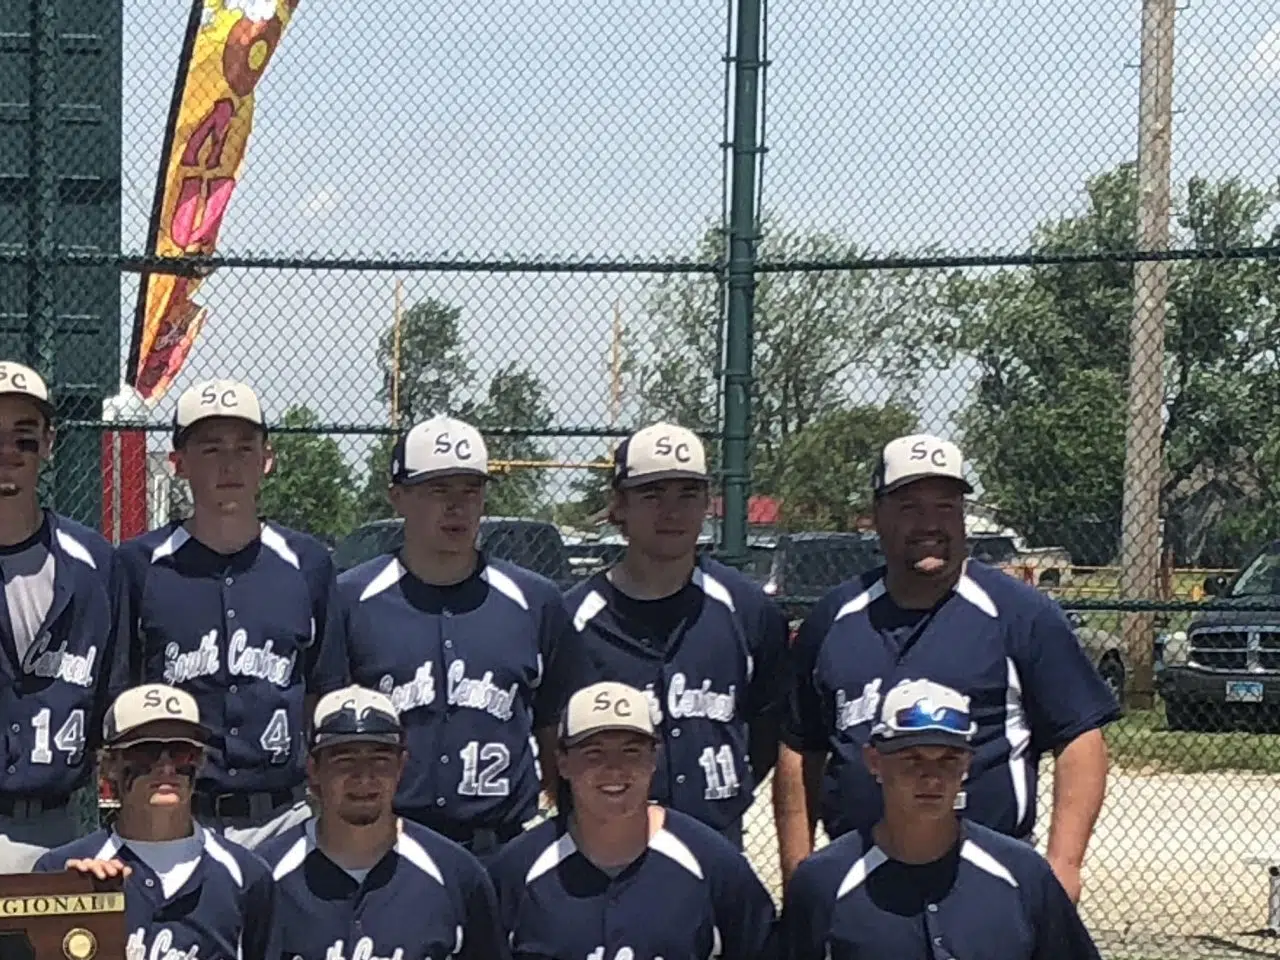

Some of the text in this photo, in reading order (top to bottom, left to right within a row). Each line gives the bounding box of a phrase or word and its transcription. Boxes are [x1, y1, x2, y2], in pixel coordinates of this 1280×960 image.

[165, 629, 296, 688] South Central
[446, 659, 518, 721] Central
[31, 707, 87, 764] 14
[260, 708, 291, 764] 4
[457, 741, 510, 796] 12
[698, 744, 740, 800] 11
